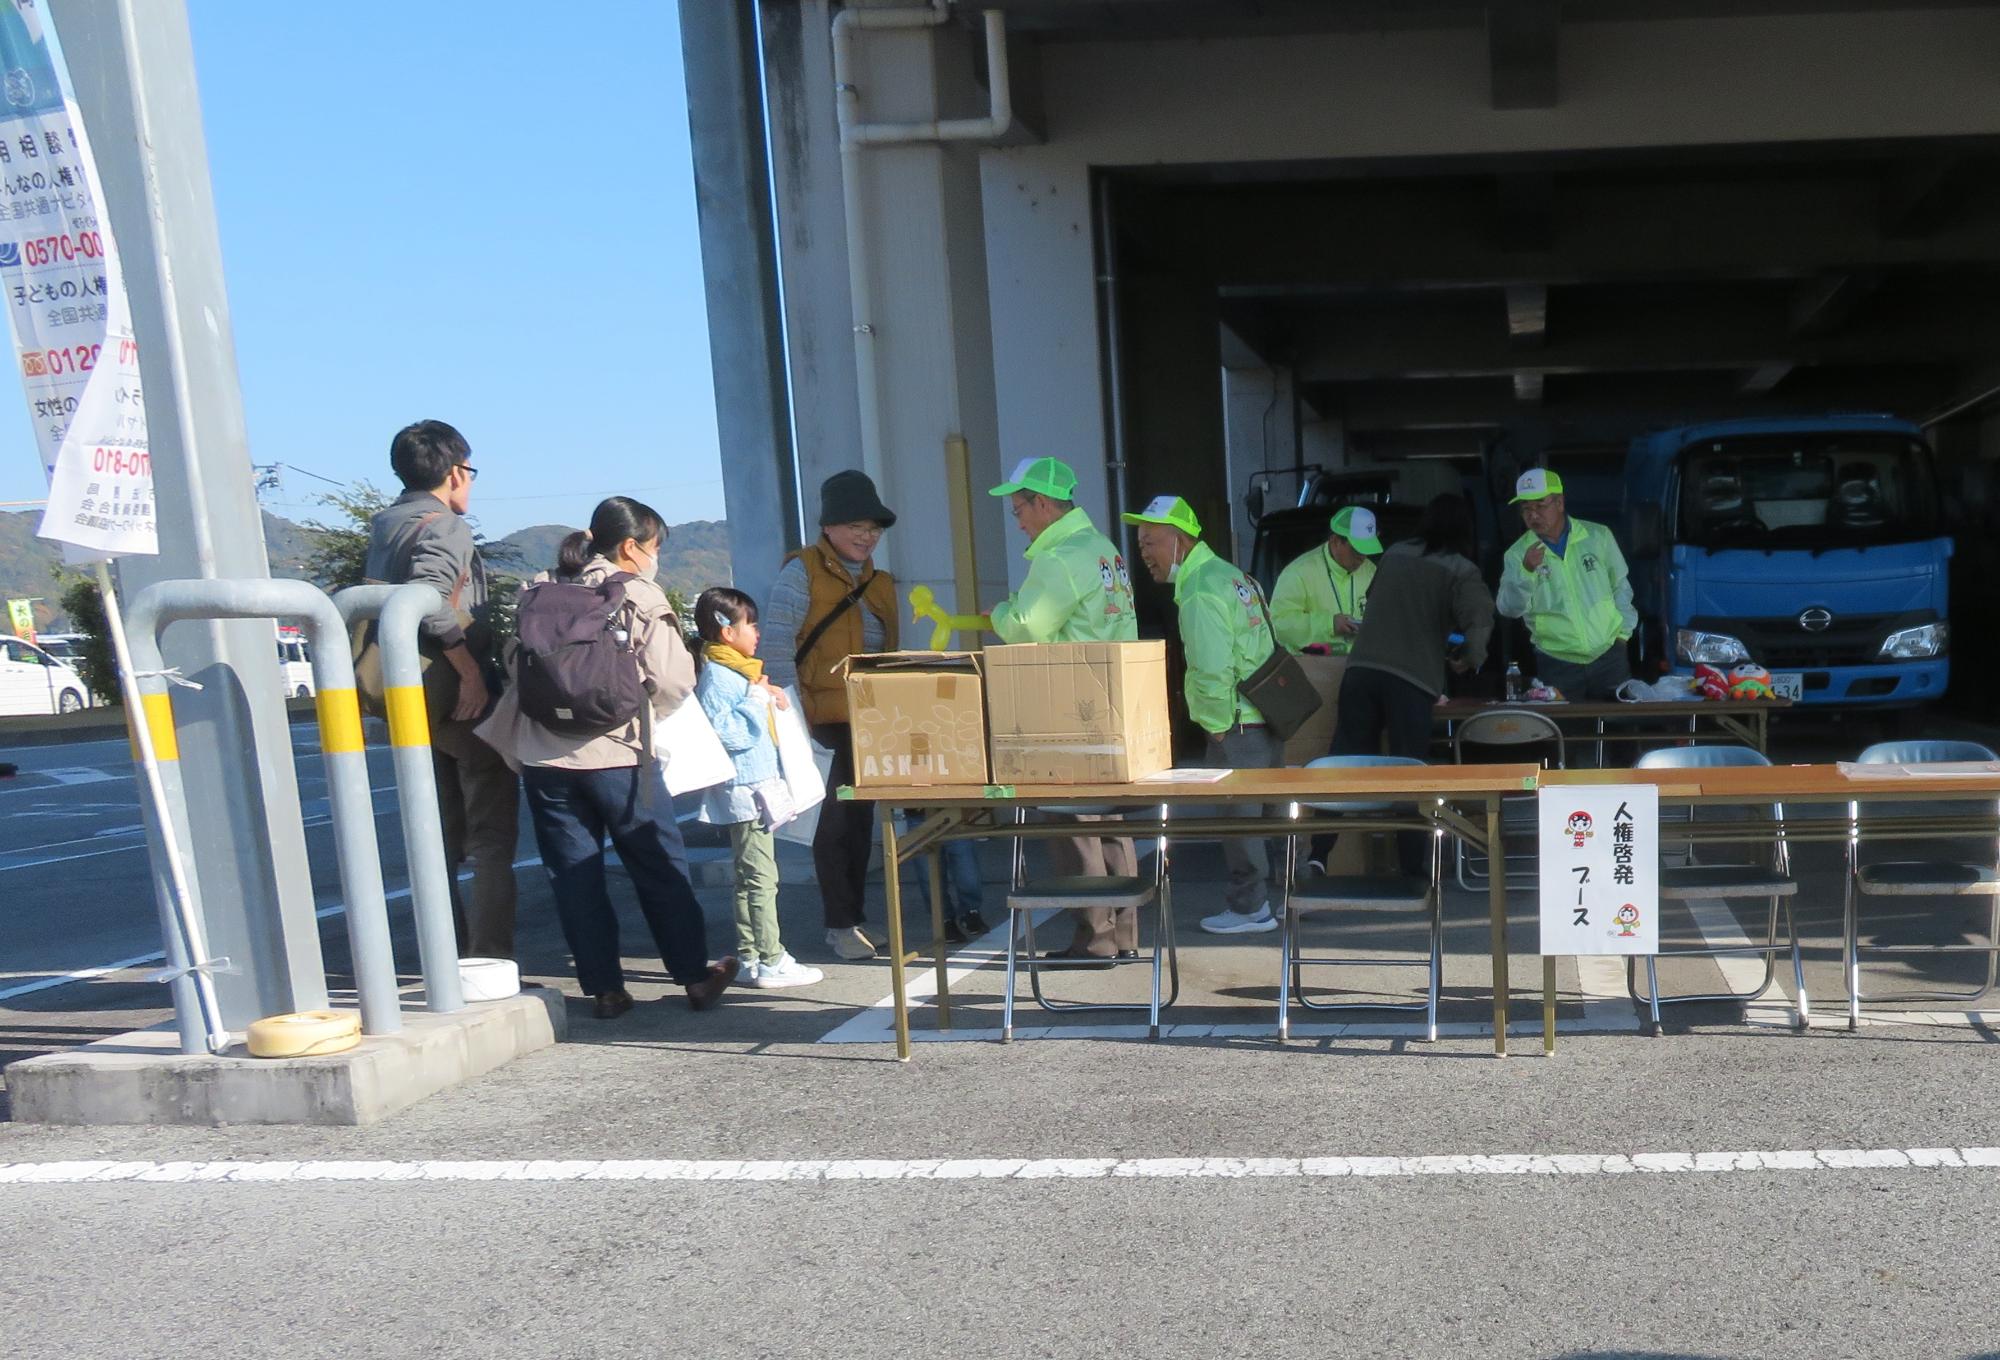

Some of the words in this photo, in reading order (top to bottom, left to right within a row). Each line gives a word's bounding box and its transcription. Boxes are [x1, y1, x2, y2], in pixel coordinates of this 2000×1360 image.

[1613, 801, 1634, 885] 人権啓発
[1571, 866, 1591, 927] ブース
